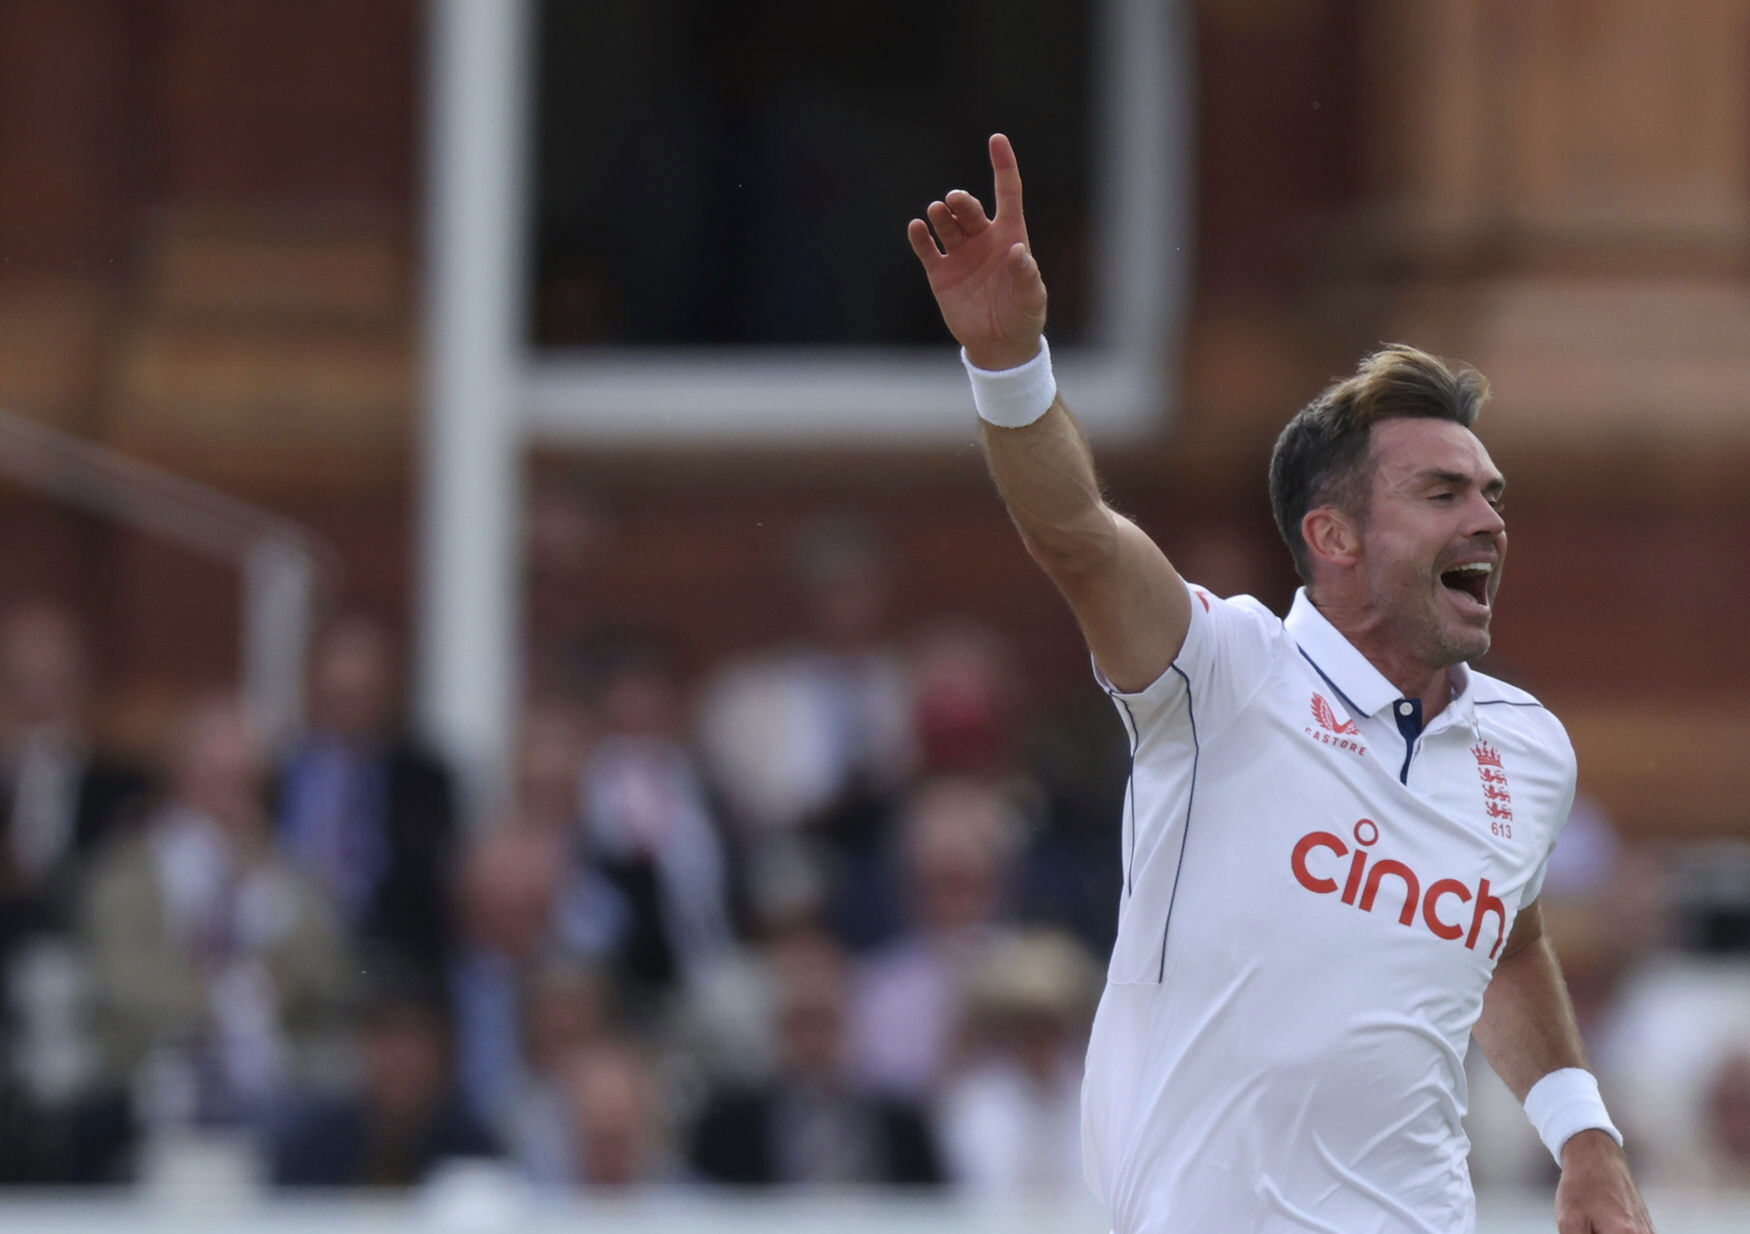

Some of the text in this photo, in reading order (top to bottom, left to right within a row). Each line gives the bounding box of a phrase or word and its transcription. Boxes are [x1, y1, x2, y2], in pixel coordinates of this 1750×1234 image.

[1304, 727, 1367, 757] CASTORE
[1490, 821, 1513, 840] 613
[1290, 818, 1506, 960] cinch
